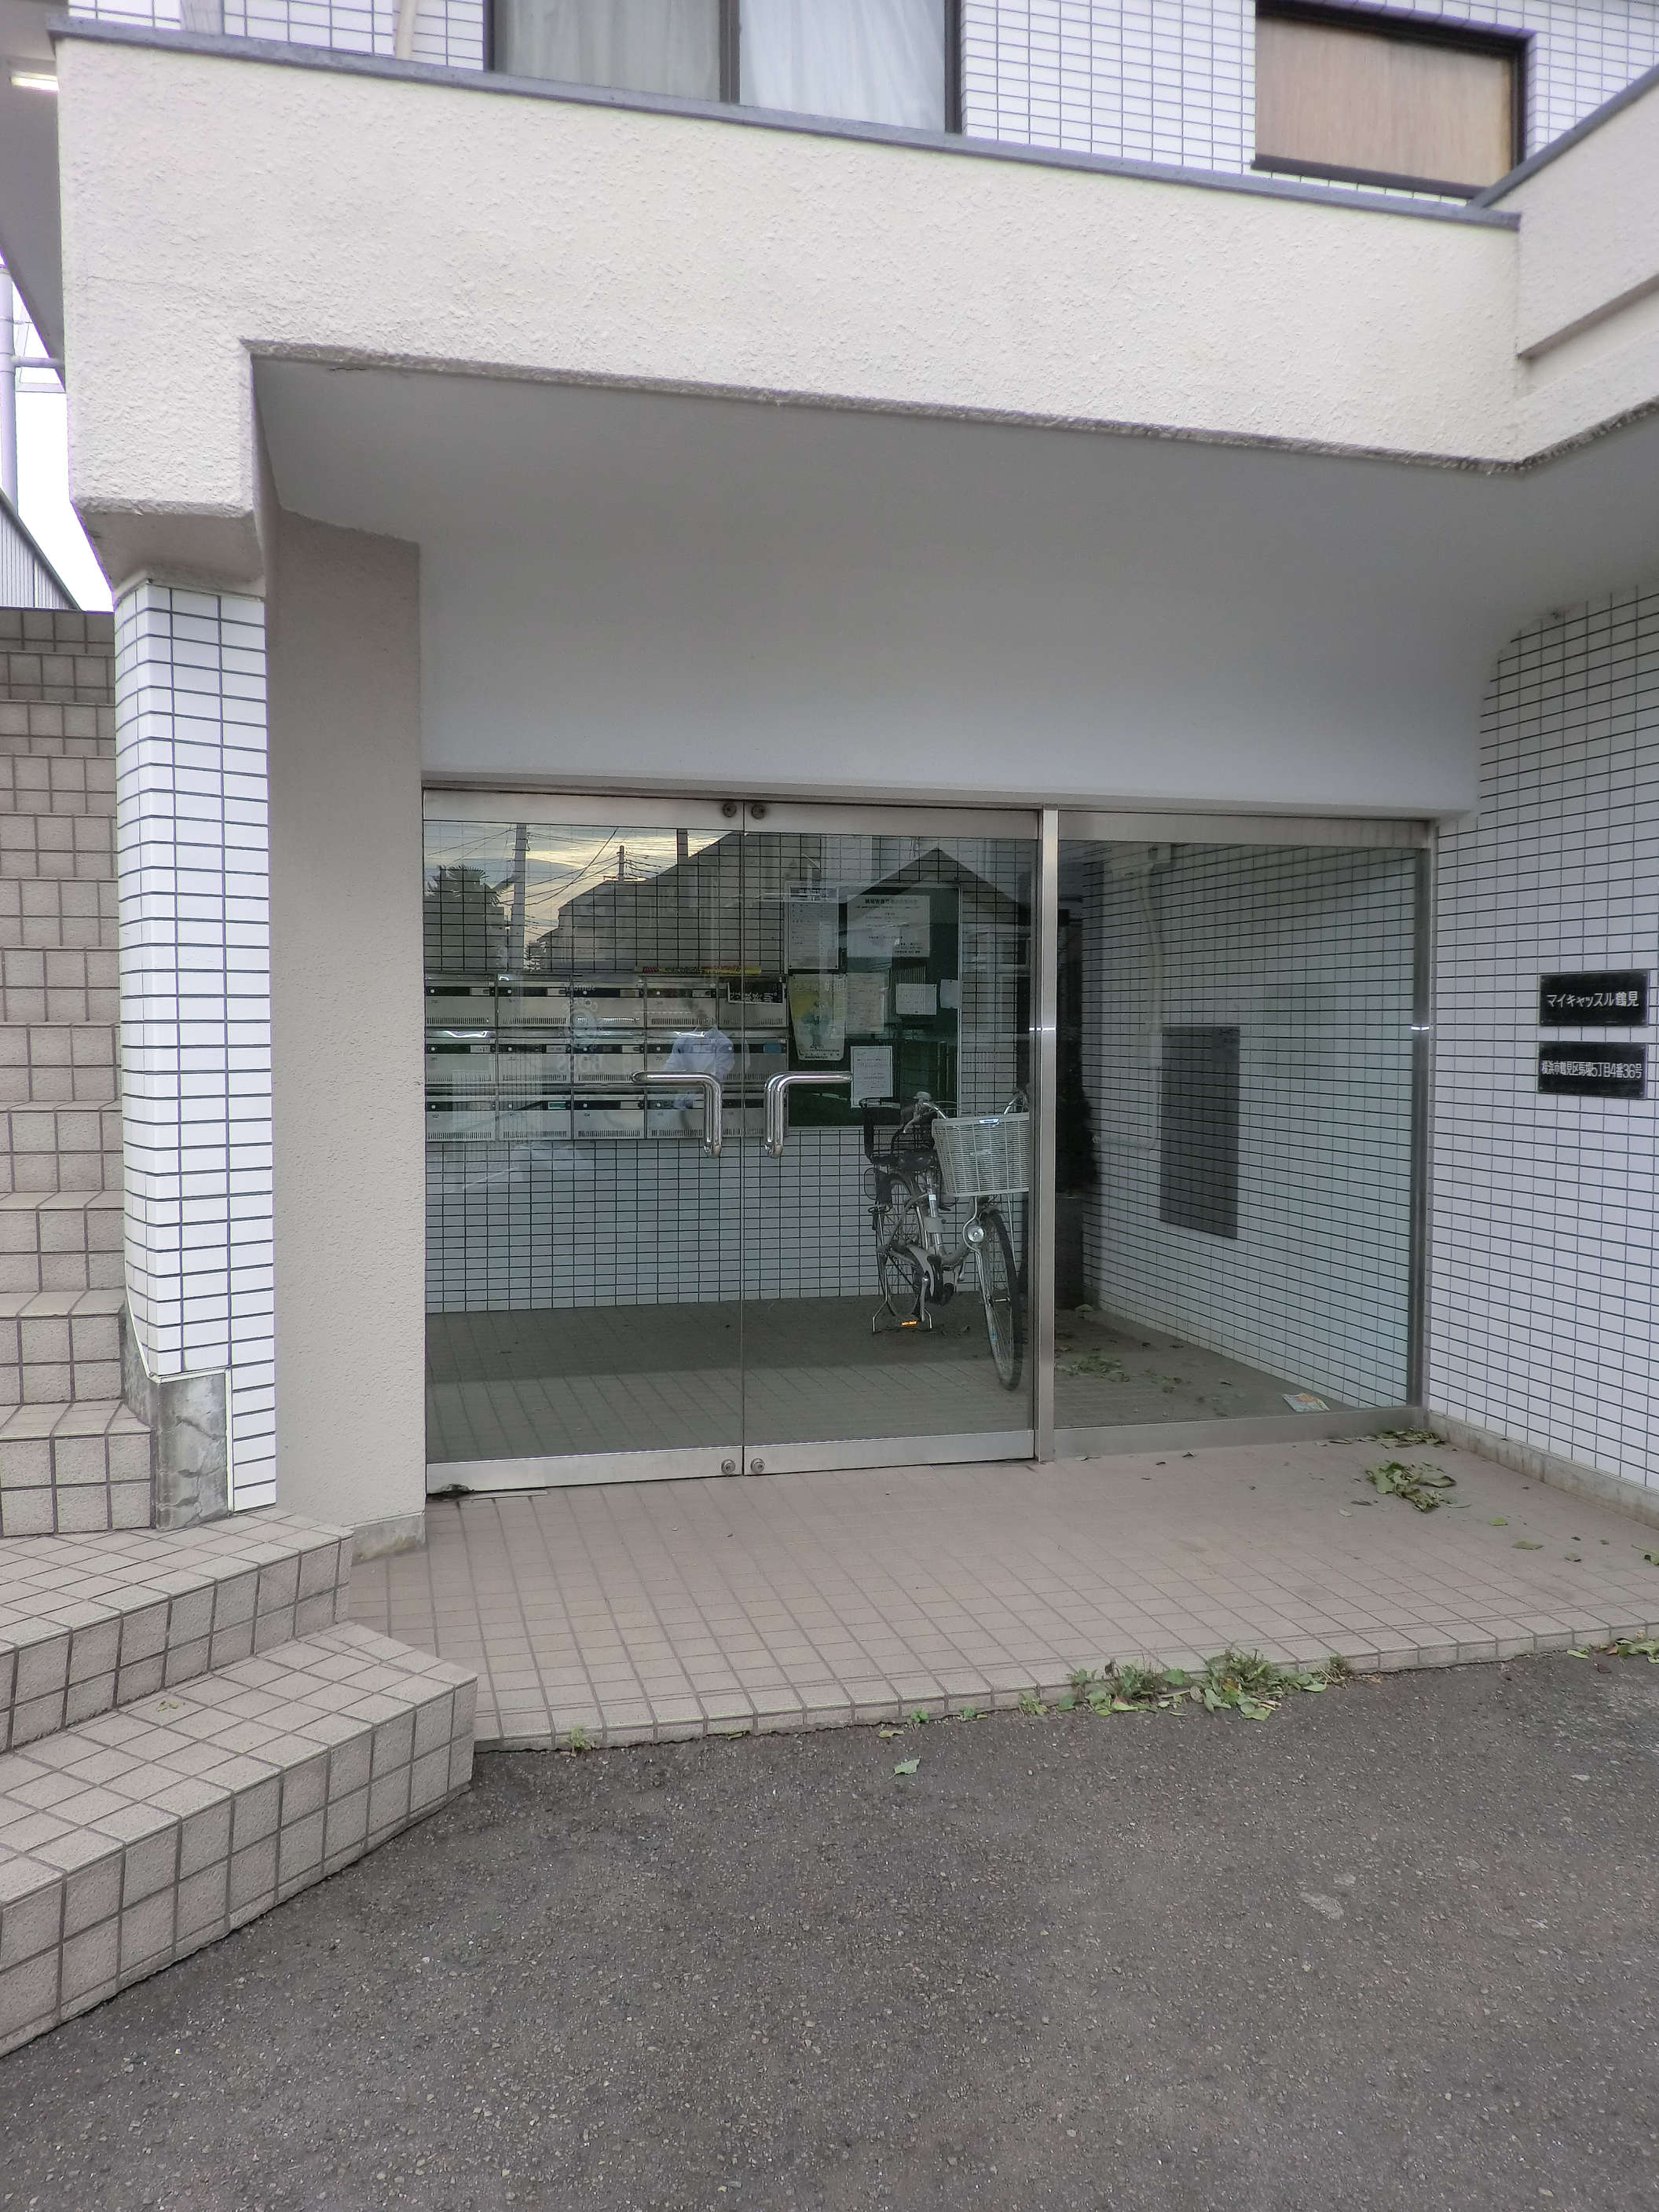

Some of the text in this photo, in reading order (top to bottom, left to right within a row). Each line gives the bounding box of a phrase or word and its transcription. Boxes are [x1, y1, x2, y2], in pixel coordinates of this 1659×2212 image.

[1547, 991, 1639, 1008] マイキャッスル鶴見
